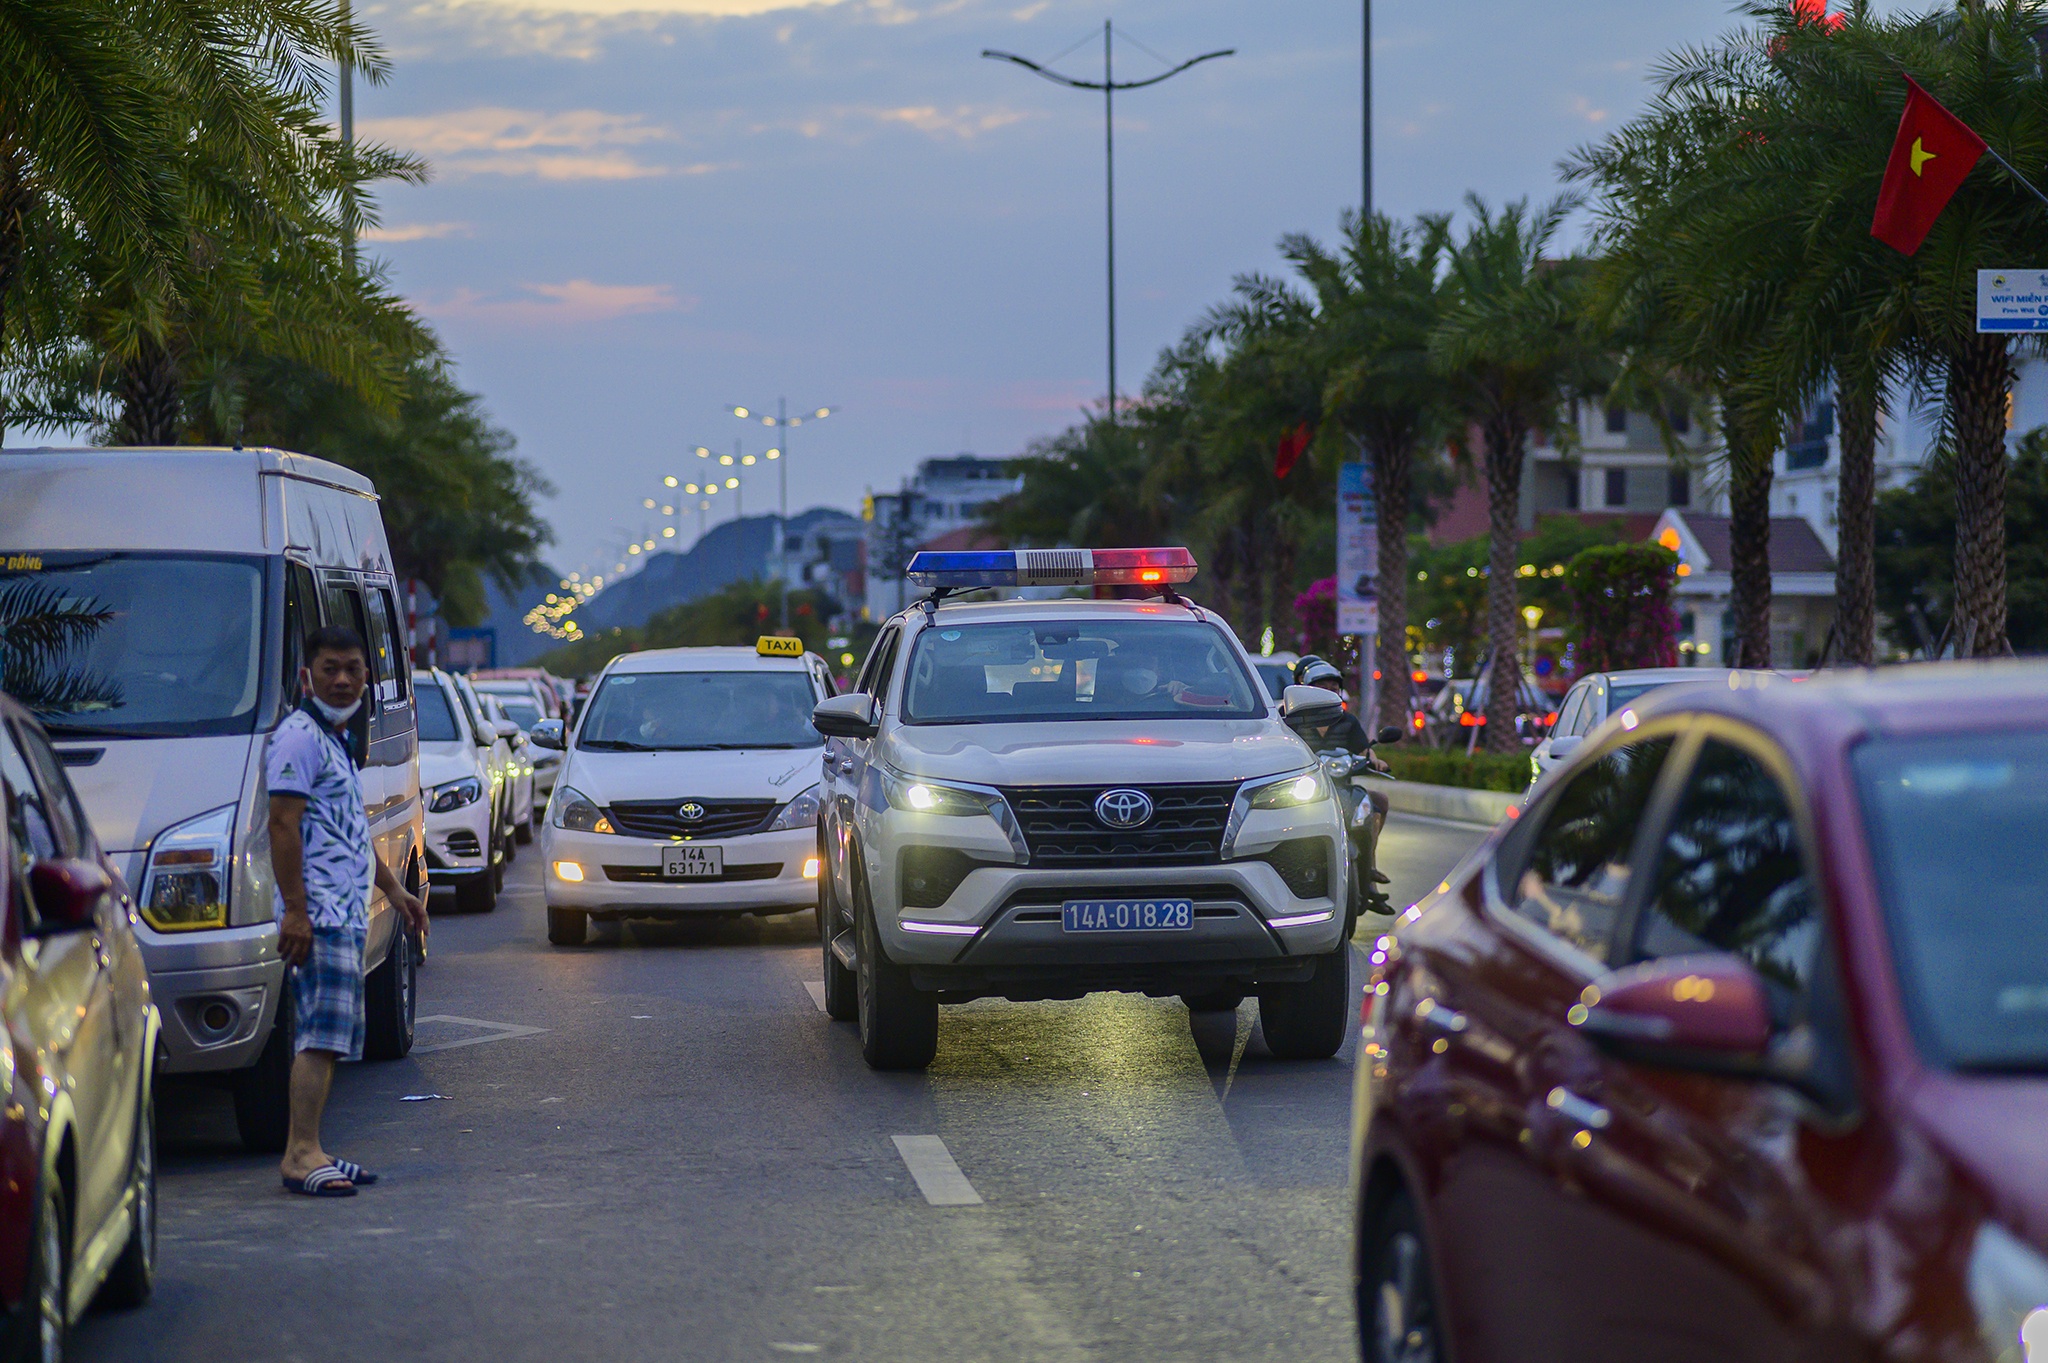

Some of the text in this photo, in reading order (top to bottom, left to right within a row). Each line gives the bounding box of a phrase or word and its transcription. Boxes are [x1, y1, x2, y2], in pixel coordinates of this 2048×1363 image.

[1991, 295, 2014, 303] WIFI
[765, 640, 797, 651] TAXI
[681, 848, 705, 861] 14A
[669, 862, 715, 875] 631.71
[1070, 903, 1189, 929] 14A-018.28
